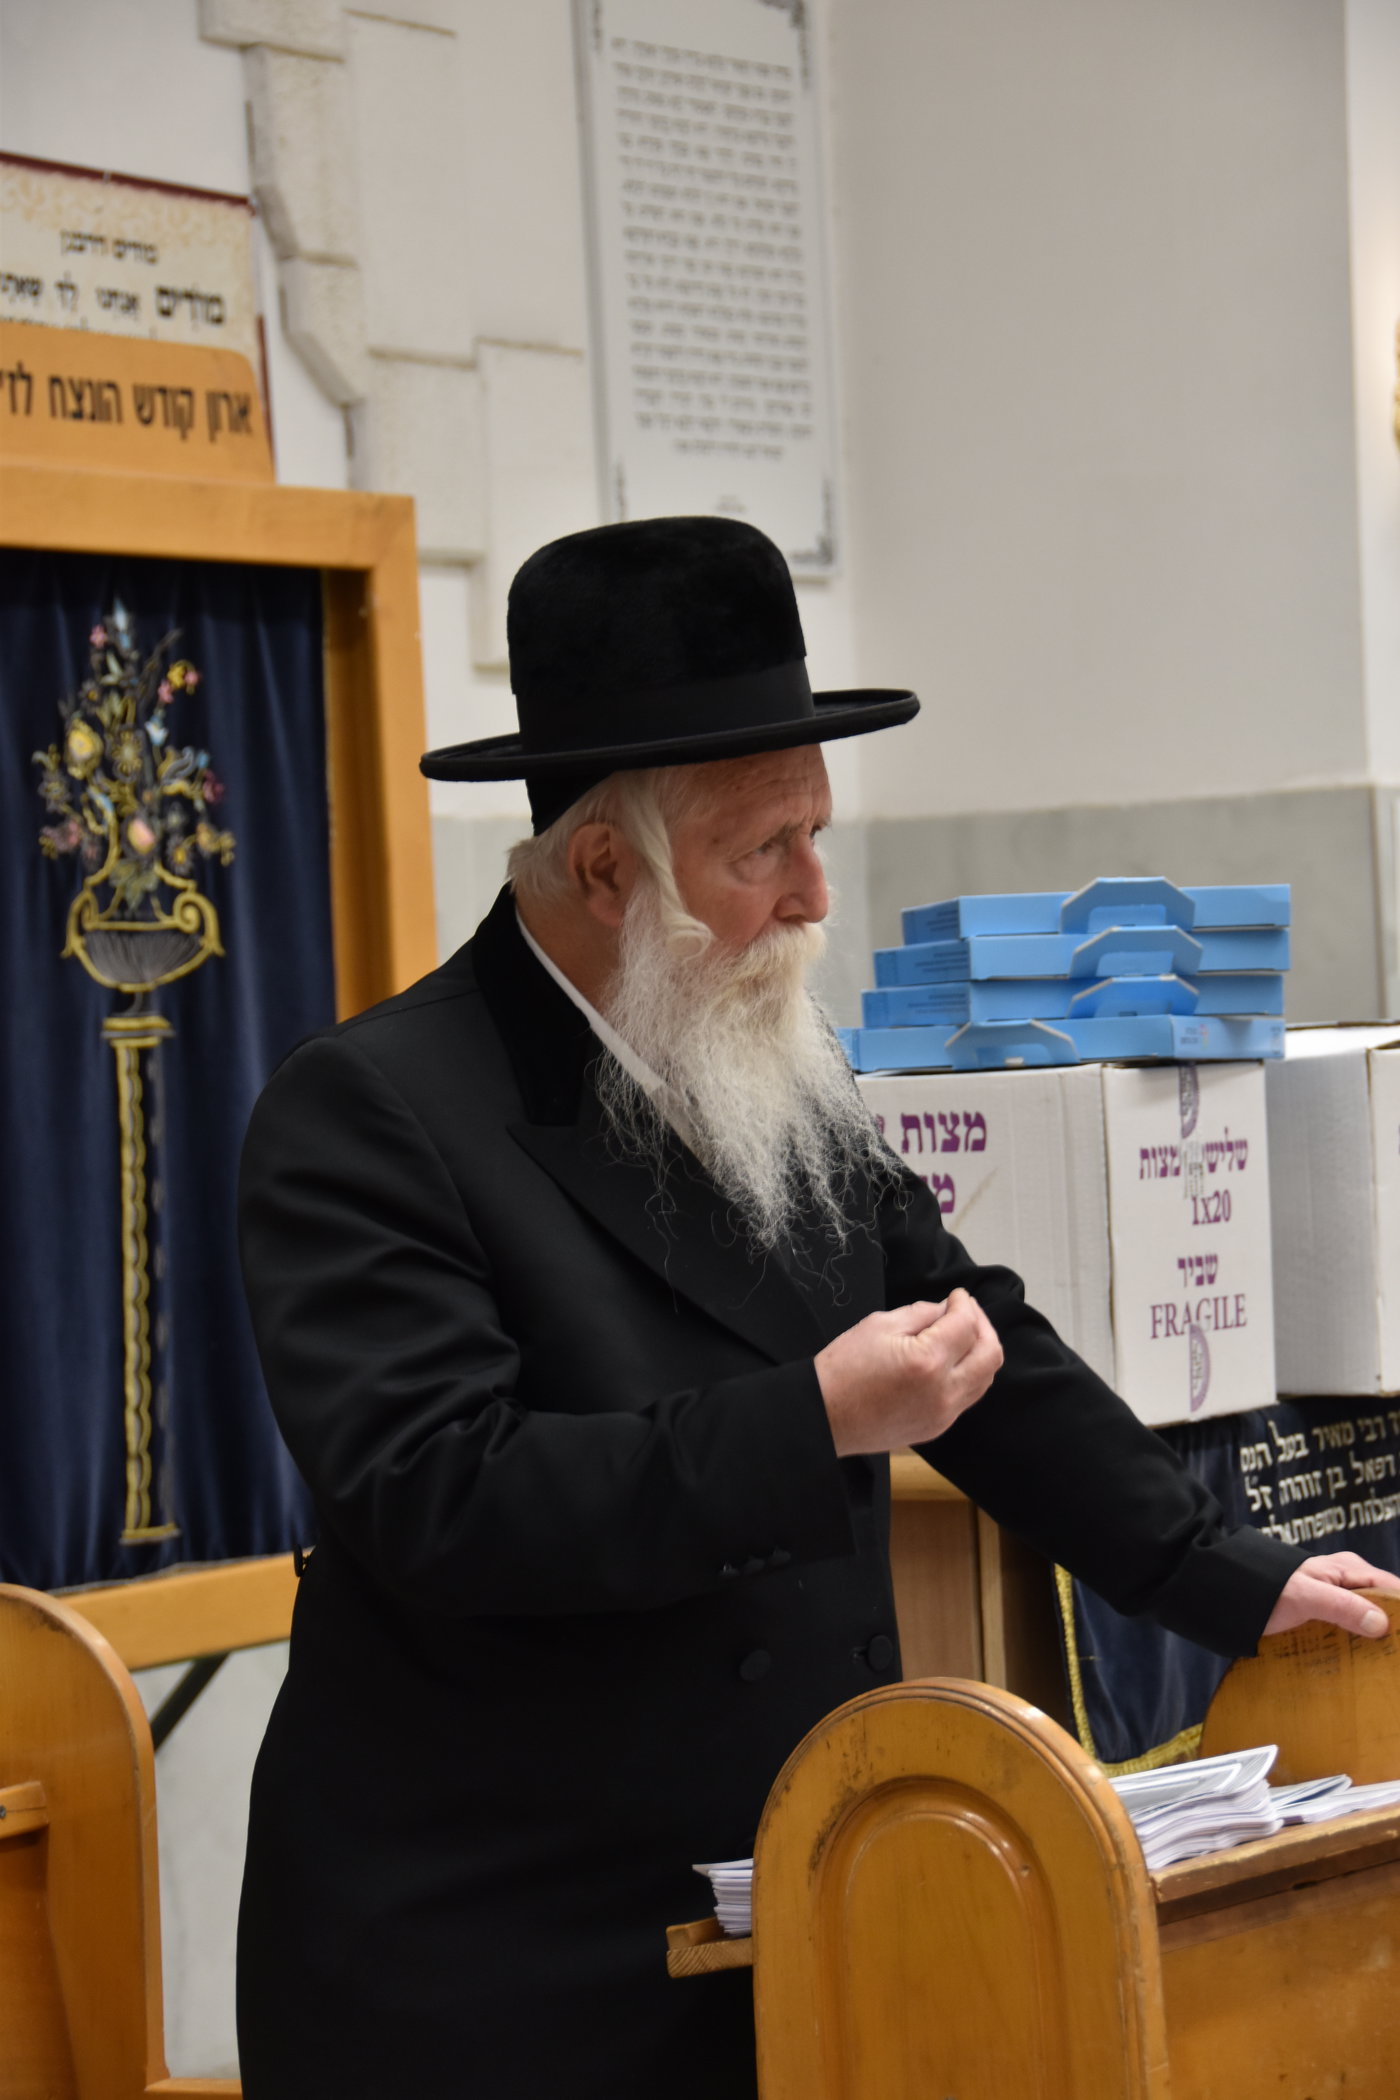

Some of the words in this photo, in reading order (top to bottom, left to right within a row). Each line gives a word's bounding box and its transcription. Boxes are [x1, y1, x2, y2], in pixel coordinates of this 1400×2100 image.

[155, 284, 226, 326] מודים
[131, 381, 195, 441] קודש
[205, 387, 253, 444] ארון
[900, 1110, 988, 1154] מצות
[1139, 1145, 1182, 1180] מצות
[1191, 1188, 1232, 1226] 1x20
[1177, 1253, 1219, 1288] שביר
[1150, 1293, 1248, 1340] FRAGILE
[1268, 1420, 1310, 1463] בעל
[1311, 1420, 1356, 1452] מאיר
[1357, 1415, 1387, 1442] רבי
[1240, 1442, 1273, 1473] הנס
[1349, 1450, 1396, 1485] רפאל
[1326, 1466, 1347, 1500] בן
